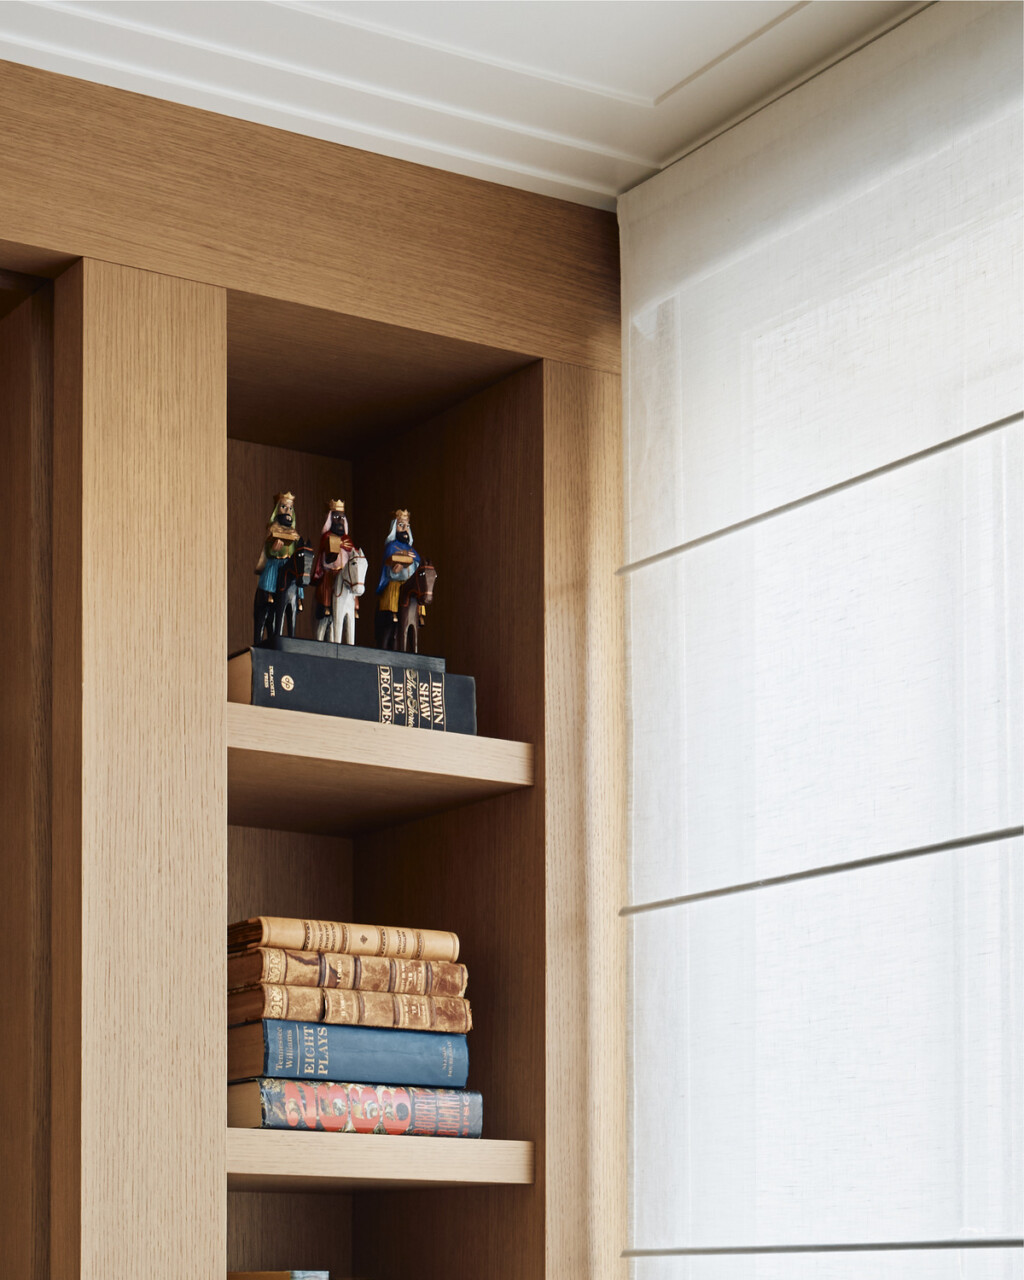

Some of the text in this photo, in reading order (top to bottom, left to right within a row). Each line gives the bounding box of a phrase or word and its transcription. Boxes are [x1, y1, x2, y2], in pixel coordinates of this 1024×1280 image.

[393, 682, 405, 714] FIVE
[419, 682, 431, 721] SHAW
[432, 682, 444, 725] IRWIN
[275, 1026, 284, 1071] Tennessee
[285, 1029, 294, 1068] Williams
[303, 1026, 315, 1074] EIGHT
[317, 1026, 329, 1075] PLAYS
[412, 1089, 436, 1134] ROBERTO
